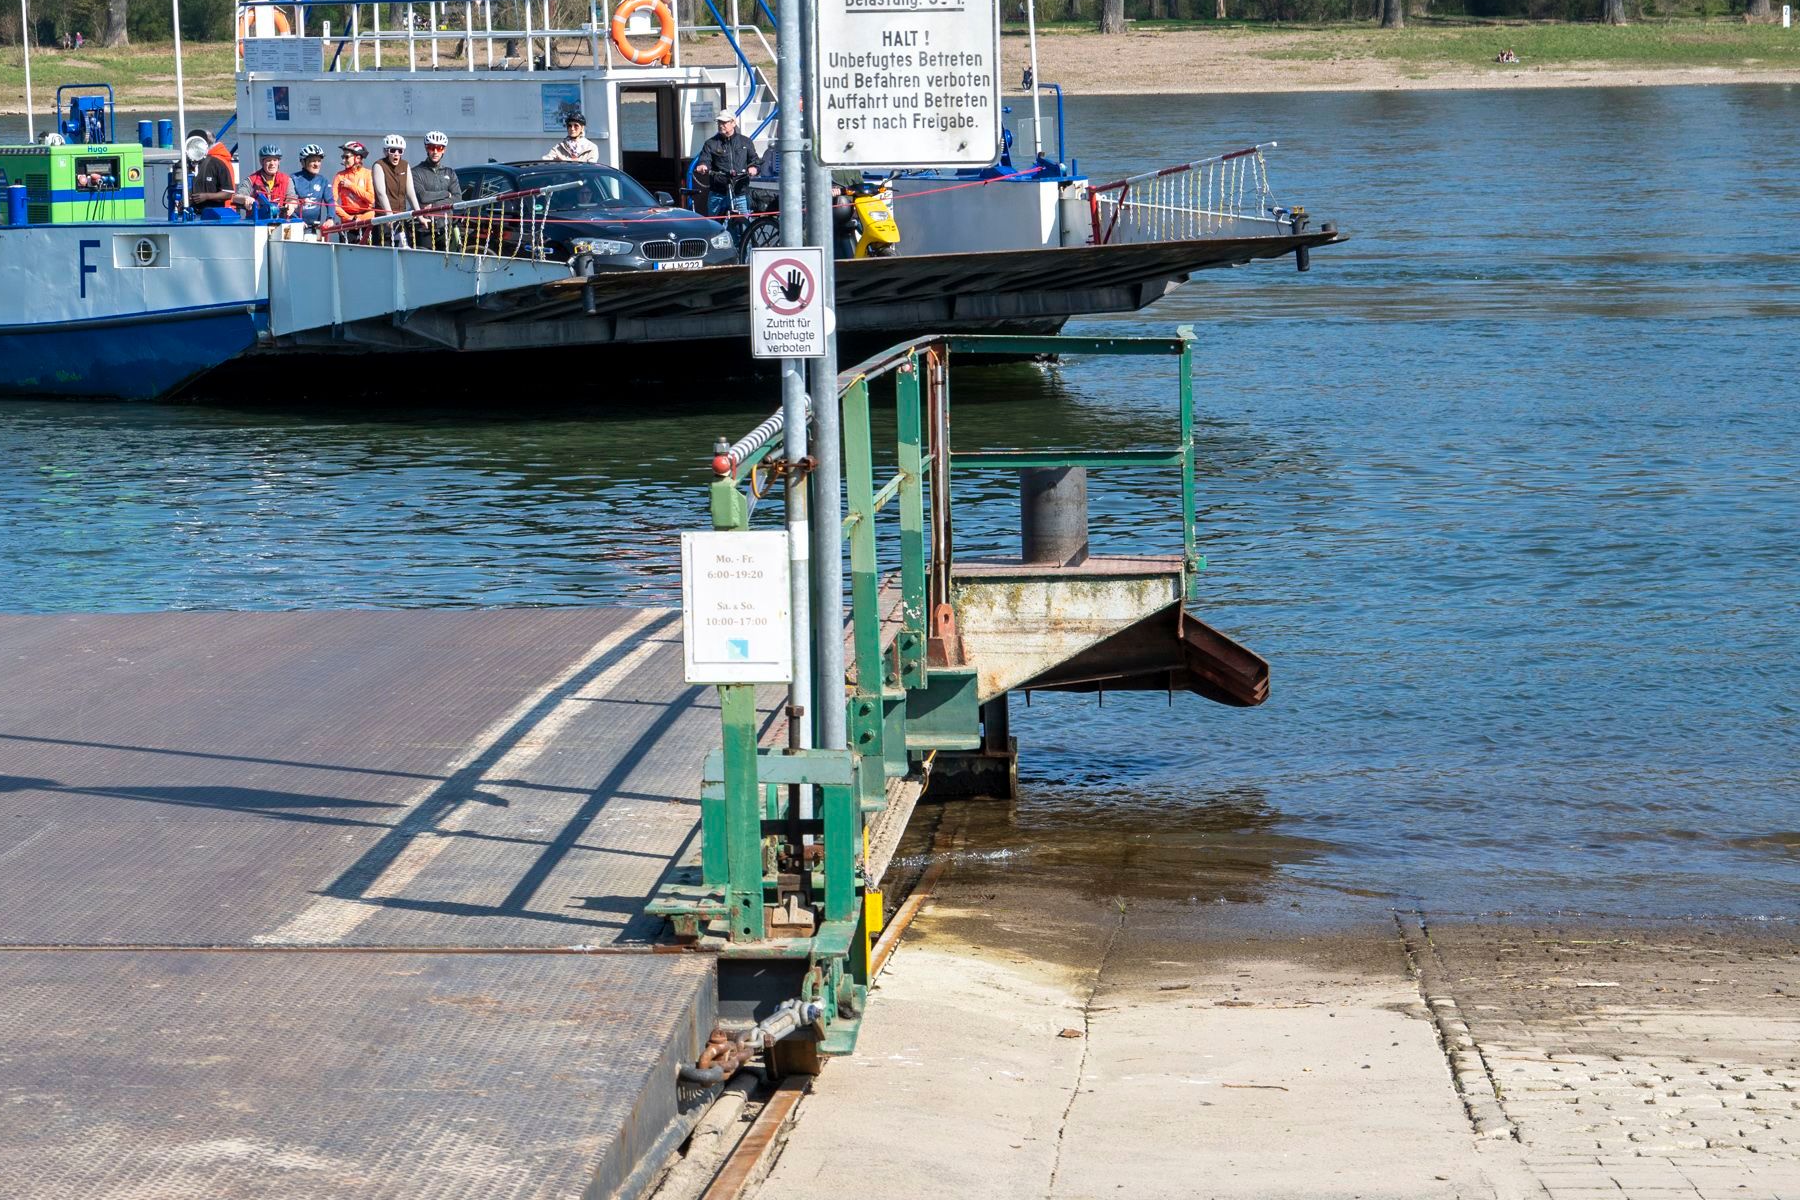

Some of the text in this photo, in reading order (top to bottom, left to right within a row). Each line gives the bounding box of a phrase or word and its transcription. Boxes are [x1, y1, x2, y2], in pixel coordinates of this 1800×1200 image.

[882, 30, 919, 47] HALT
[829, 51, 983, 71] Unbefugtes Betreten
[823, 71, 990, 89] und Befahren verboten
[827, 92, 988, 110] Auffahrt und Betreten
[837, 112, 979, 132] erst nach Freigabe.
[87, 145, 108, 154] Hugo
[79, 239, 101, 299] F
[766, 318, 811, 328] Zutritt für
[763, 330, 815, 342] Unbefugte
[767, 342, 811, 353] verboten
[716, 554, 734, 563] Mo.
[742, 554, 755, 563] Fr.
[716, 601, 732, 610] Sa.
[740, 601, 755, 610] So.
